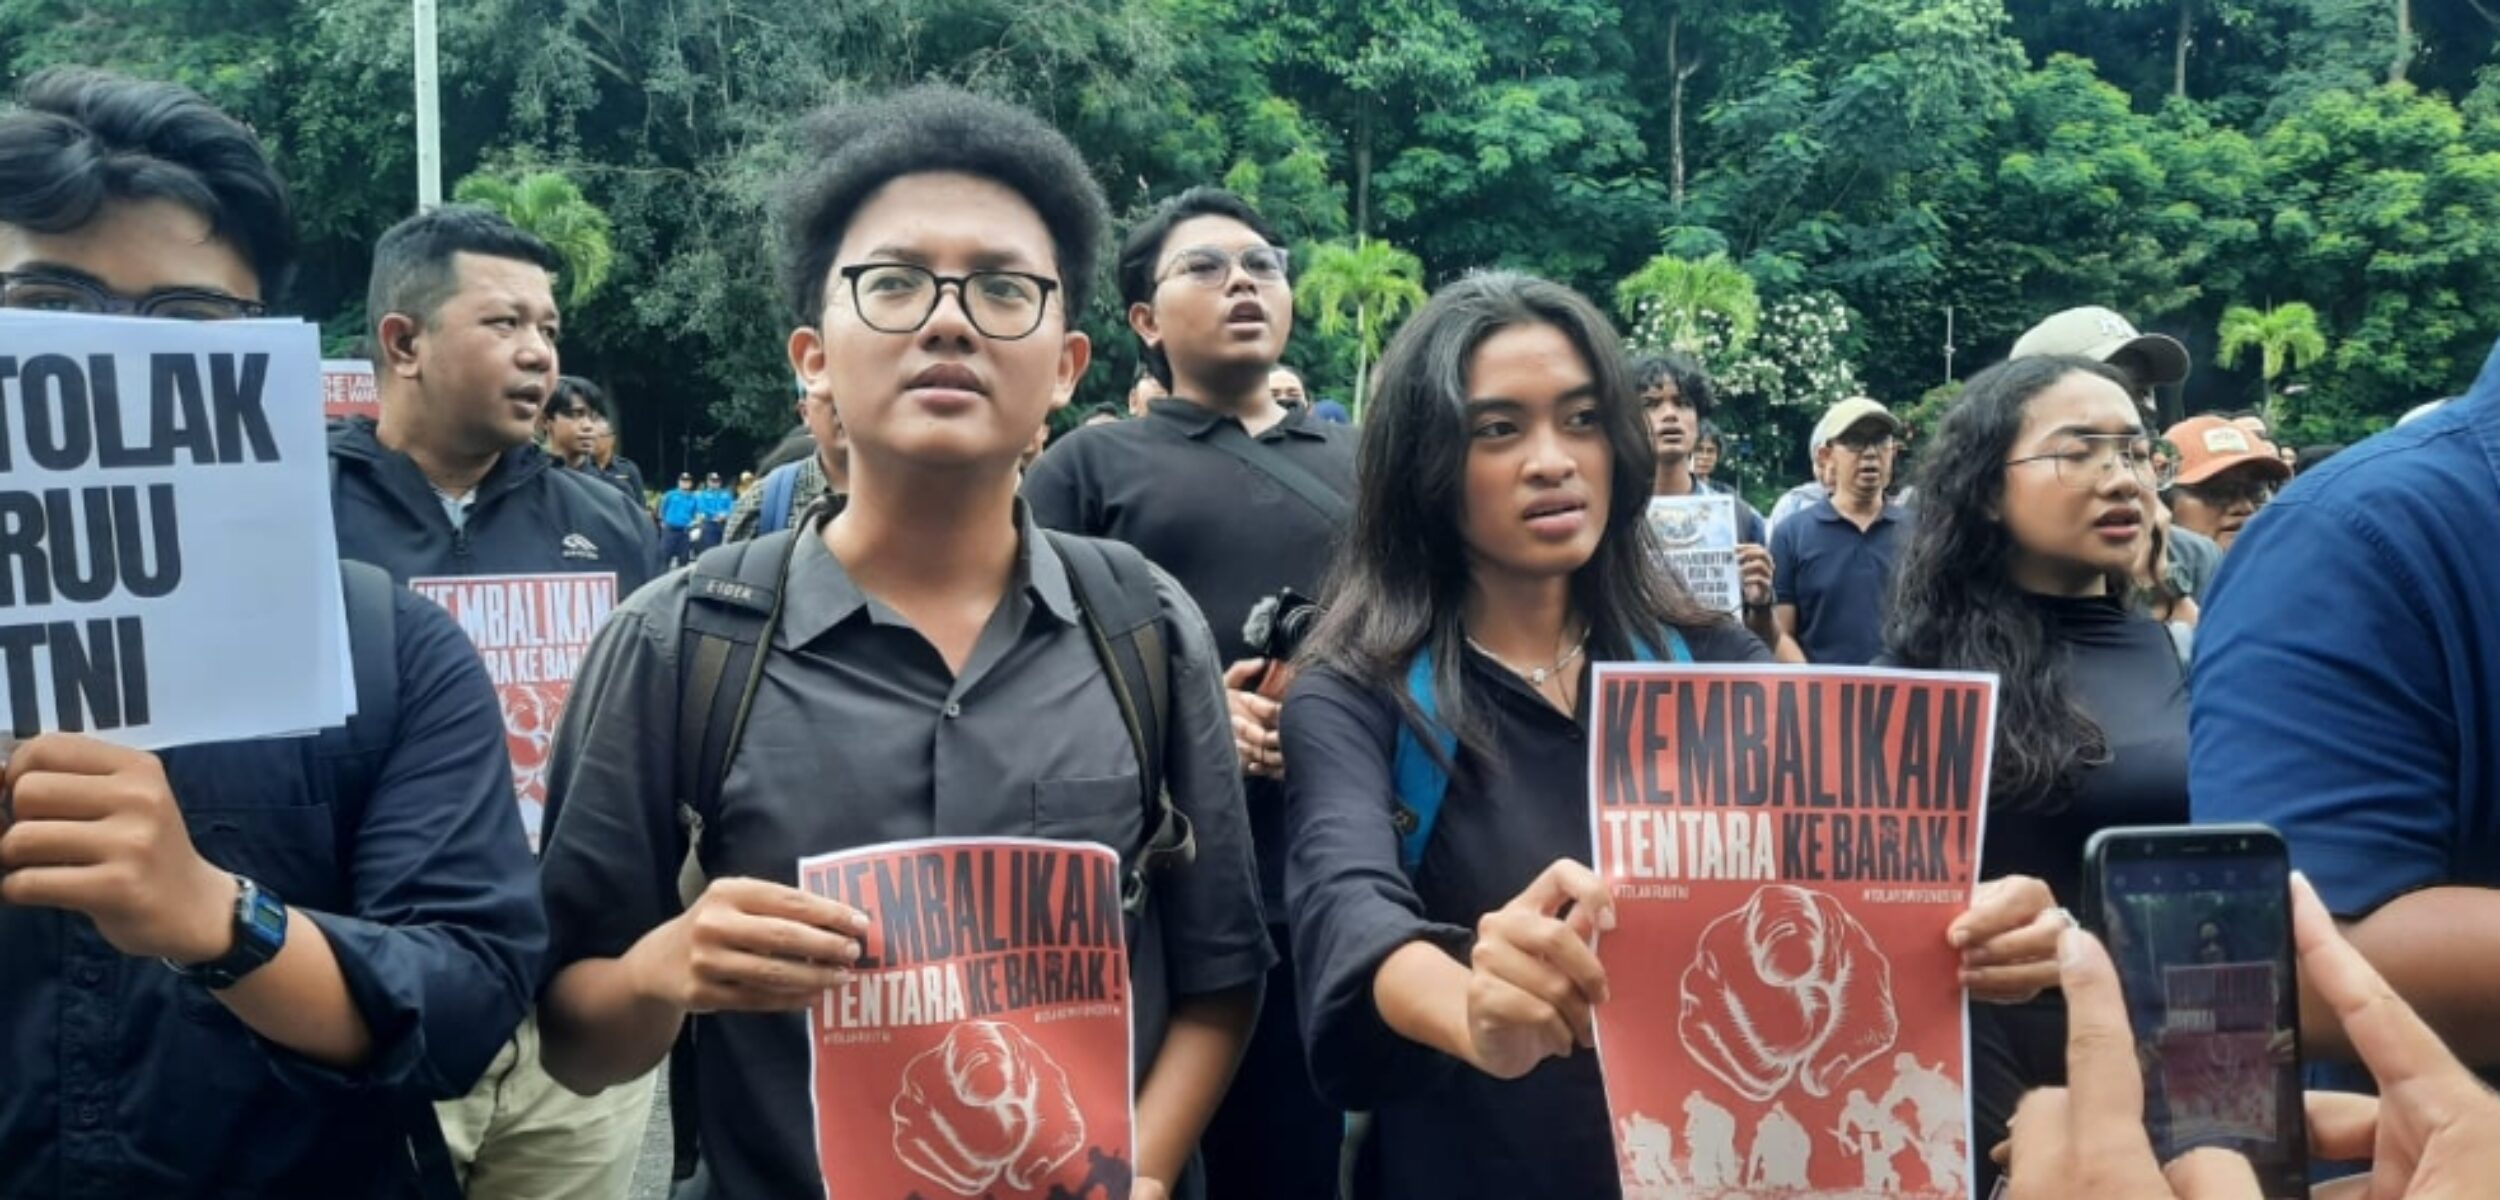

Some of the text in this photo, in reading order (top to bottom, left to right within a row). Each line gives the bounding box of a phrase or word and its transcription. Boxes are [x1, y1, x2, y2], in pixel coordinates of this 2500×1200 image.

[0, 483, 182, 606] RUU
[416, 579, 614, 649] MBALIKAN
[0, 616, 150, 739] TNI
[516, 648, 542, 684] KE
[544, 646, 589, 682] BAR
[1603, 680, 1980, 810] KEMBALIKAN
[1604, 810, 1776, 879] TENTARA
